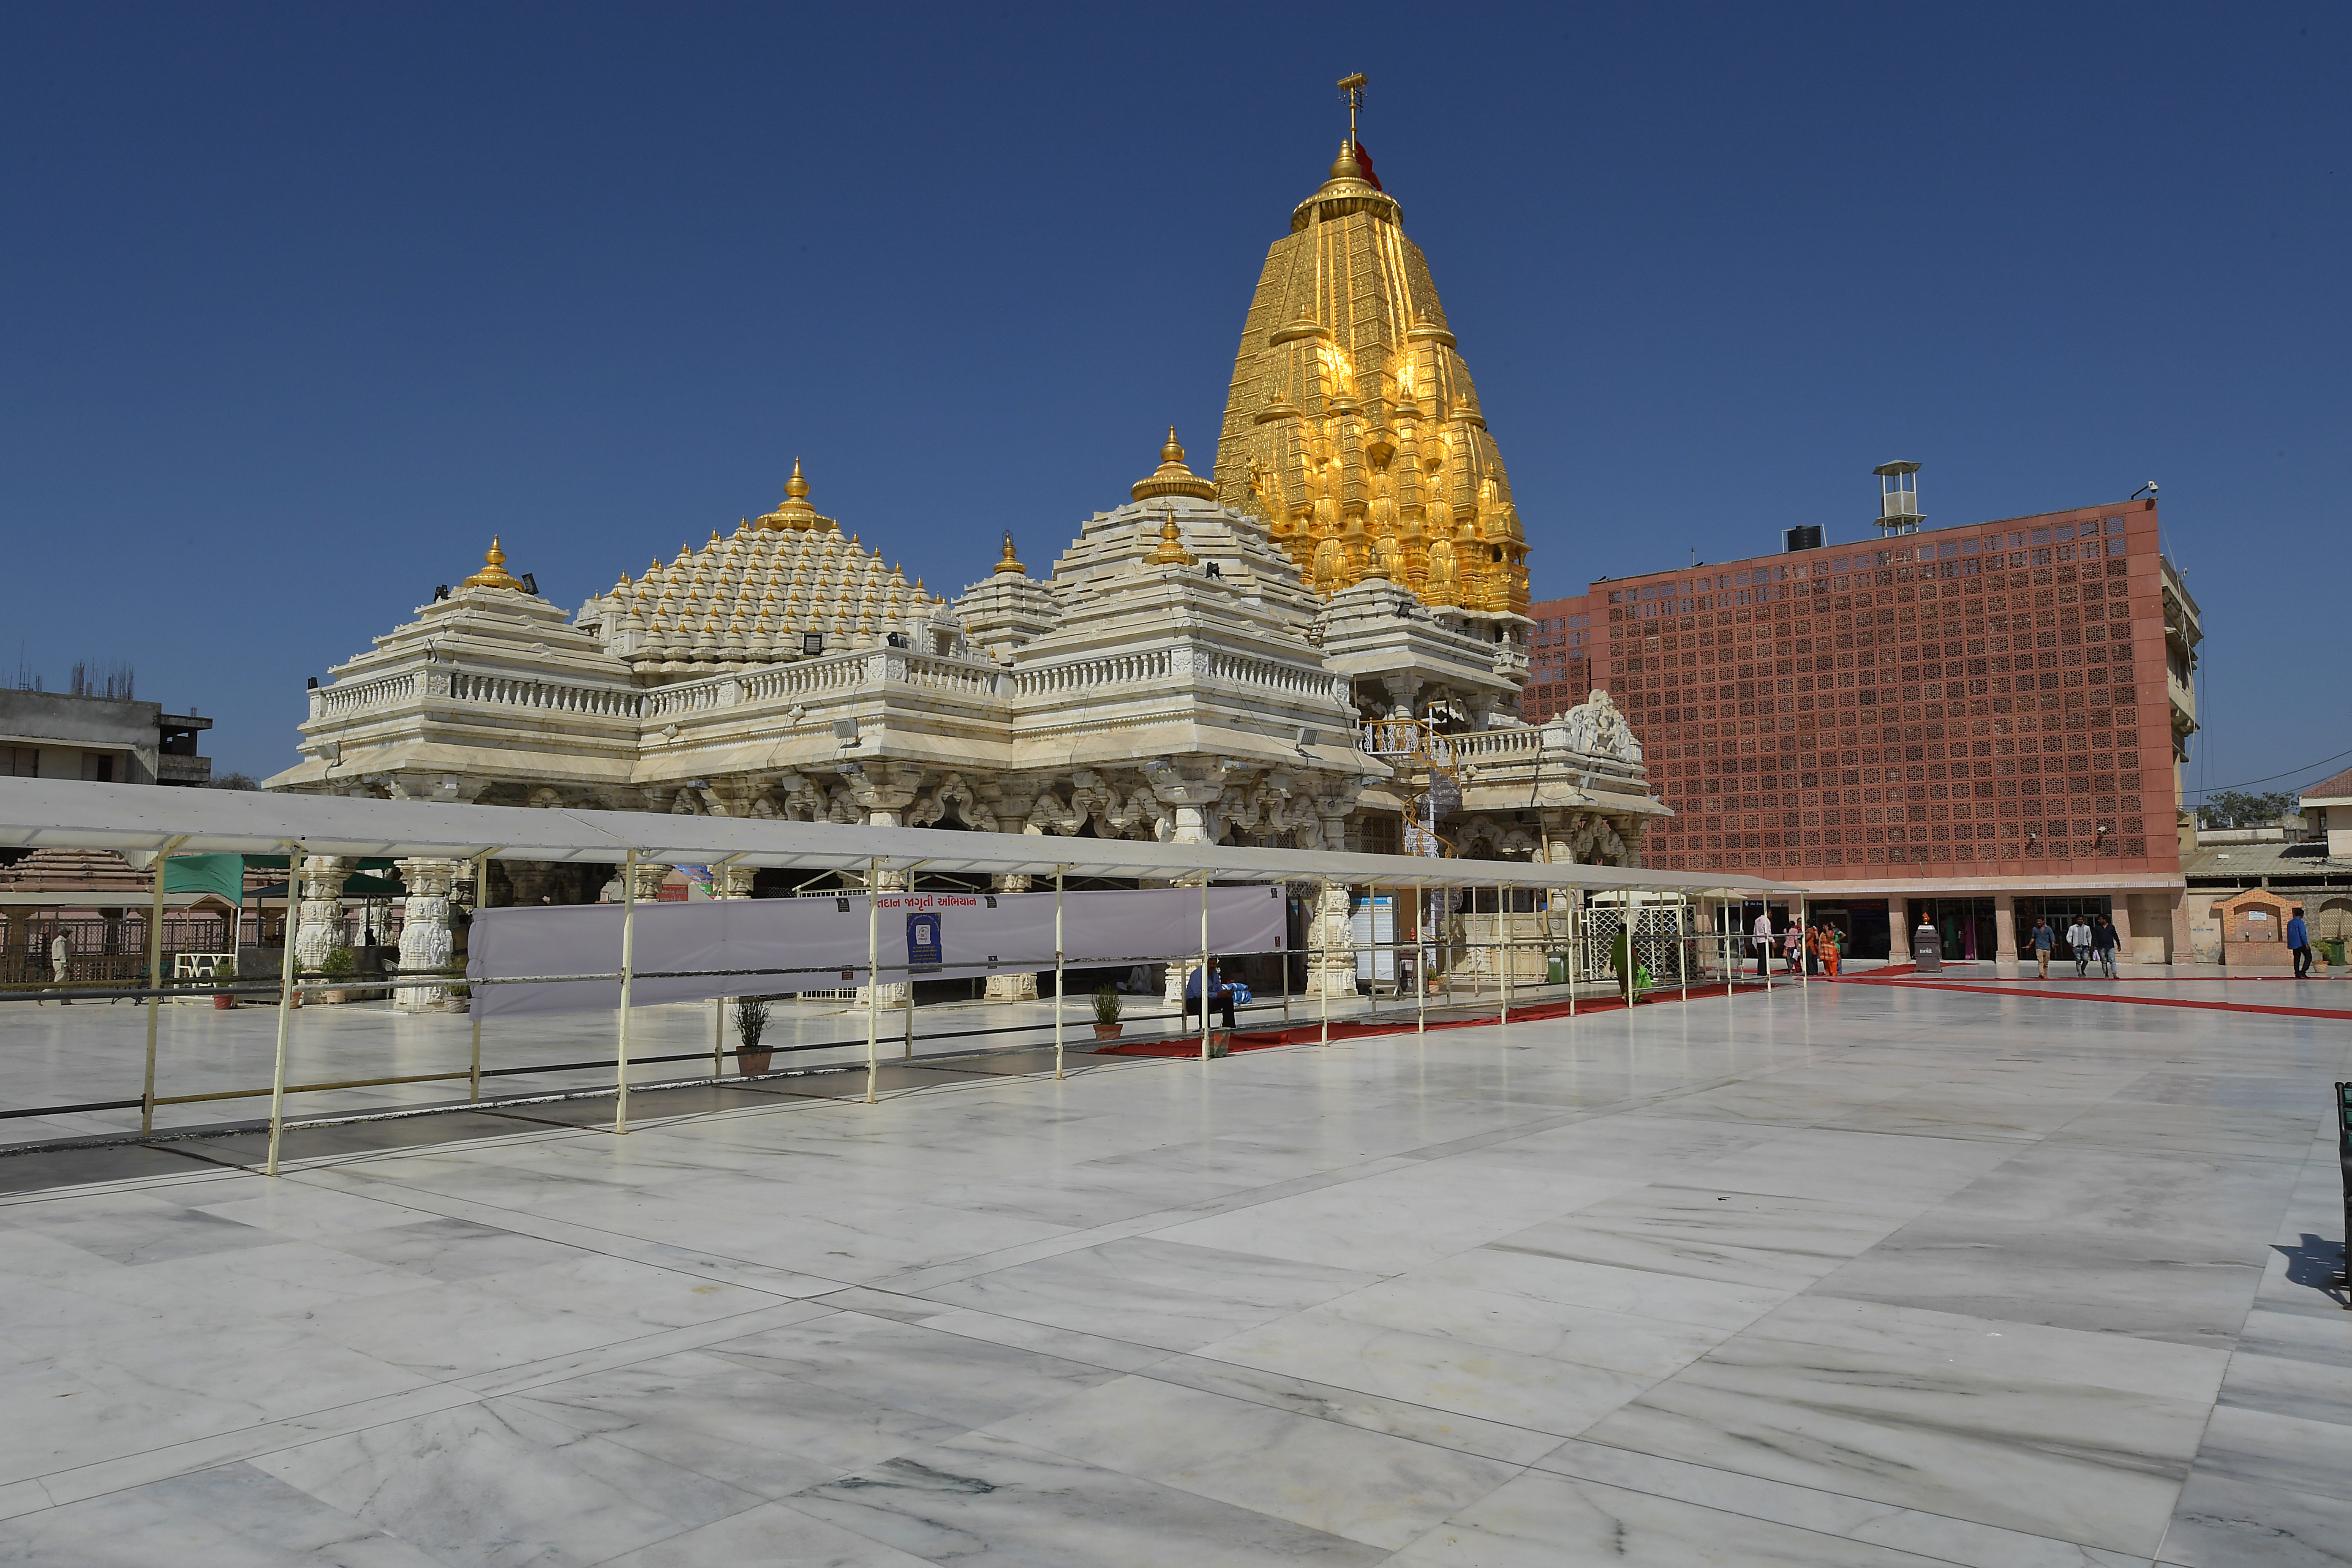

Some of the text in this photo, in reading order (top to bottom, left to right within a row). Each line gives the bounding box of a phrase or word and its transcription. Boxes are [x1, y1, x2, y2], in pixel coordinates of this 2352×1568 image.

[869, 898, 901, 908] તદાન
[904, 894, 933, 911] જાગૃતી
[938, 895, 977, 906] અભિયાન
